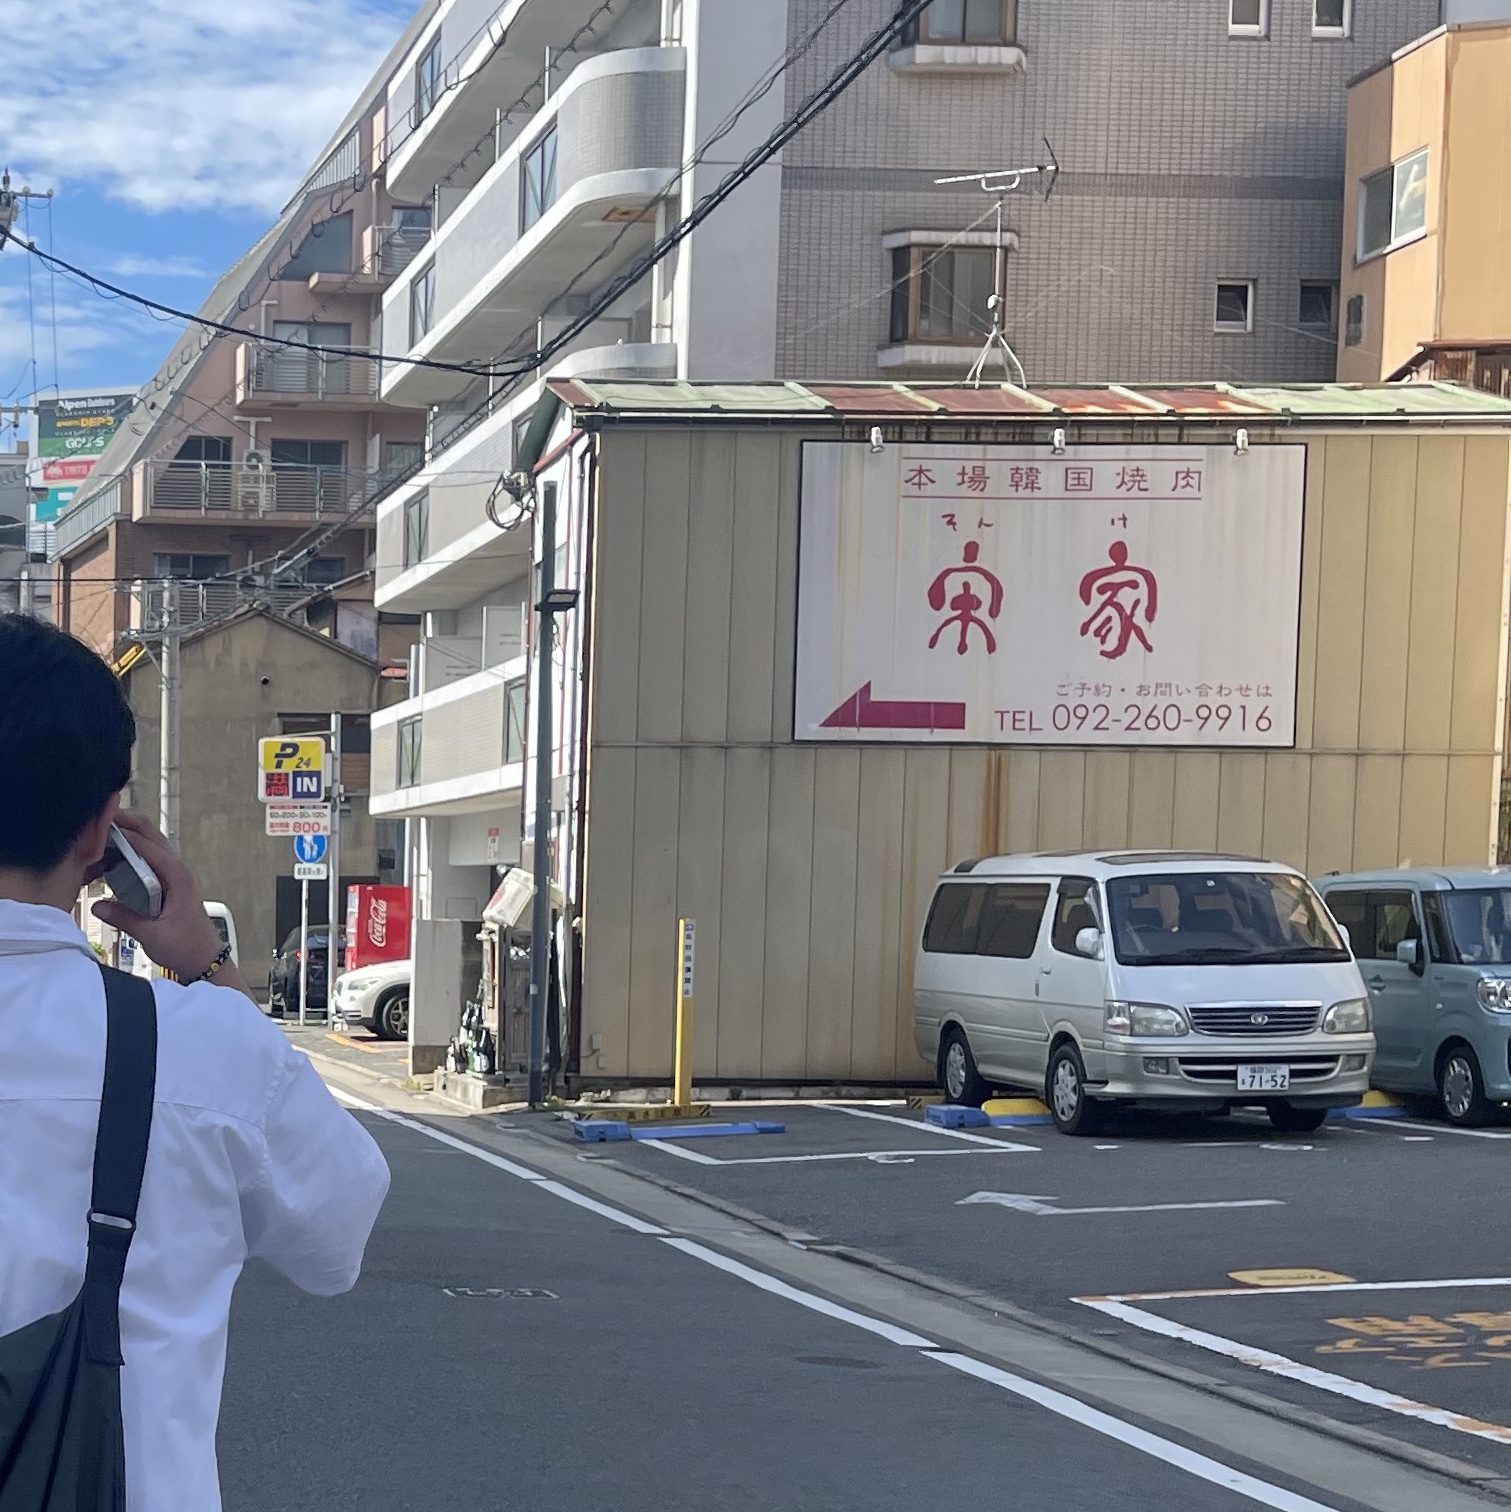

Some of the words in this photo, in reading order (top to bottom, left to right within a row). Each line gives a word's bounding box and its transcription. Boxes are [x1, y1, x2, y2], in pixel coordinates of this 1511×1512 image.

[903, 465, 1202, 493] 本場韓国焼肉
[1055, 681, 1273, 698] ご予約・お問い合わせは
[994, 710, 1042, 732] TEL
[1052, 704, 1273, 733] 092-260-9916
[295, 757, 312, 769] 24
[296, 776, 318, 793] IN
[293, 821, 321, 833] 800
[1249, 1074, 1287, 1089] 71-52
